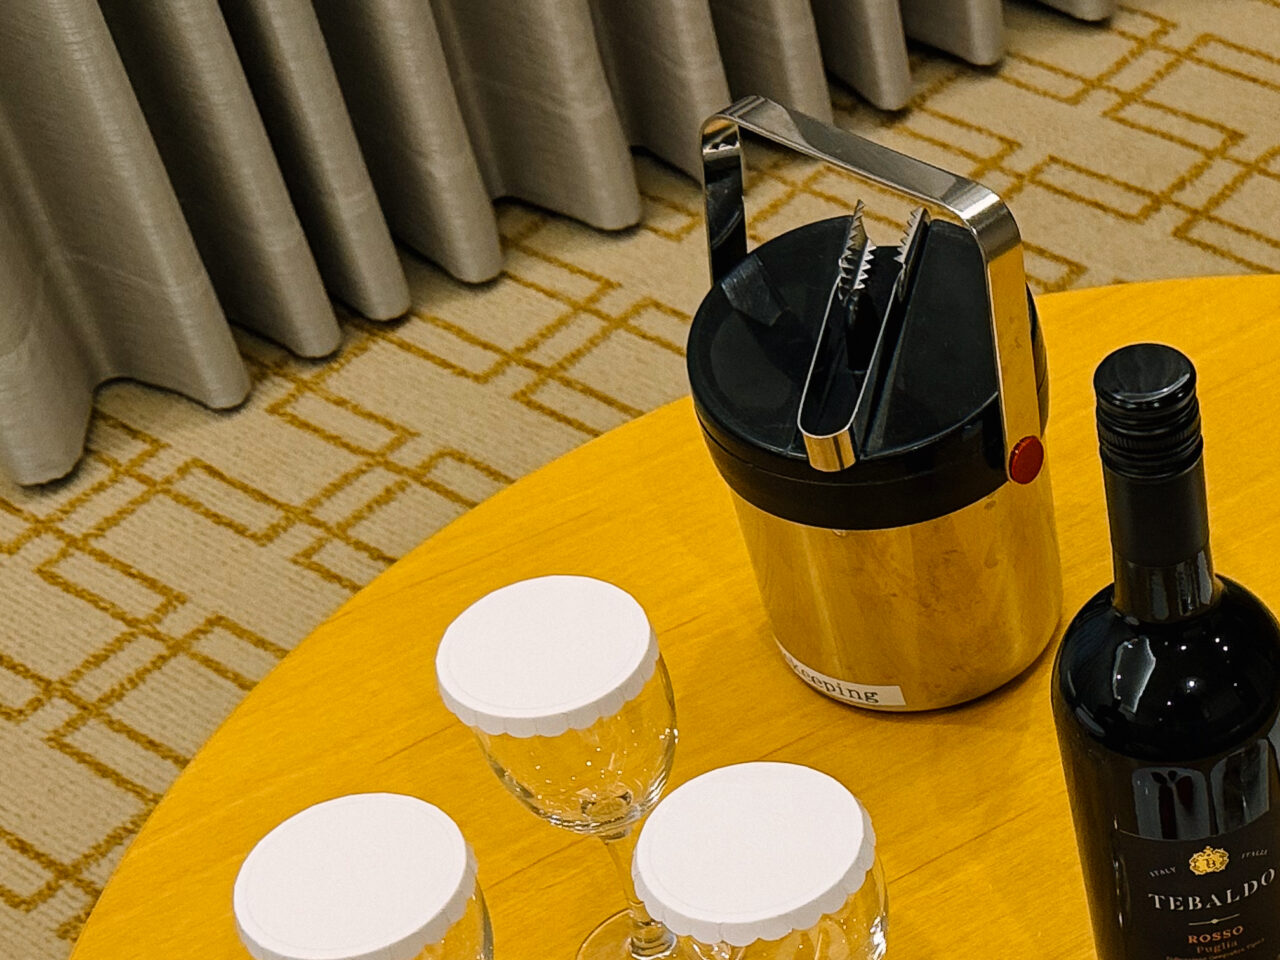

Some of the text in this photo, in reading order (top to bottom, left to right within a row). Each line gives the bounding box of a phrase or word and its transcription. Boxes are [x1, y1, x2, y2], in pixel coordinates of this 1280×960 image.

[1149, 866, 1177, 878] ITALY
[1148, 868, 1275, 911] TEBALDO
[1188, 925, 1244, 944] ROSSO
